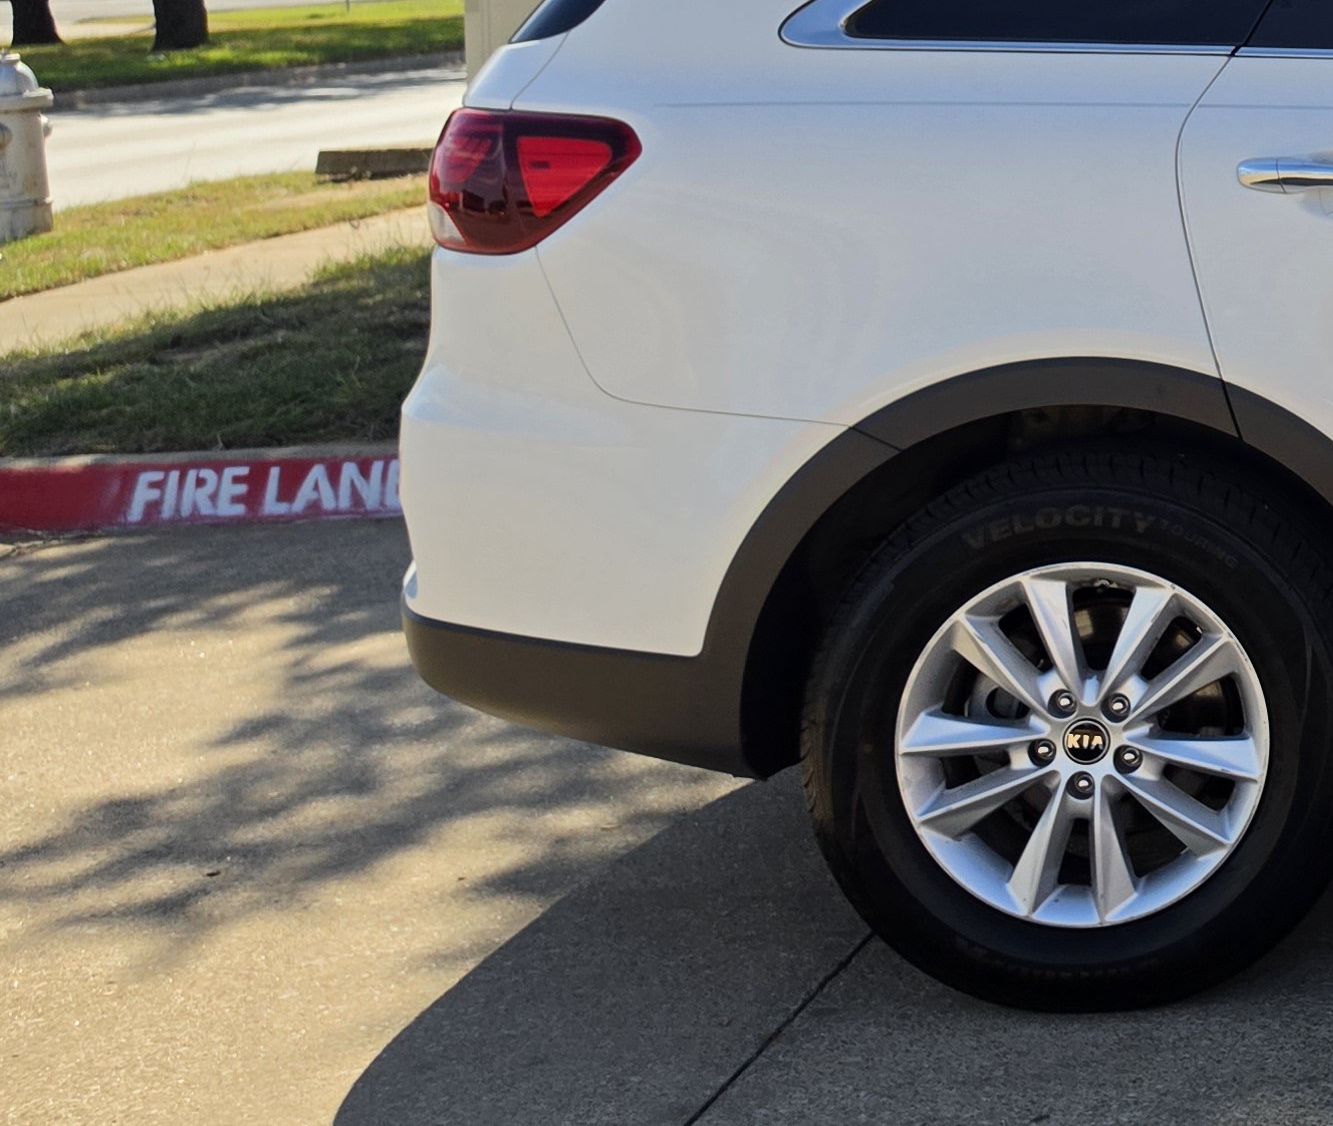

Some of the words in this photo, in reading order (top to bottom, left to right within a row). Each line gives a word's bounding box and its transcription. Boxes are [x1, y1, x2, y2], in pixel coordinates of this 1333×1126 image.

[127, 466, 249, 522] FIRE
[961, 504, 1156, 550] VELOCITY
[1067, 734, 1103, 750] KIA
